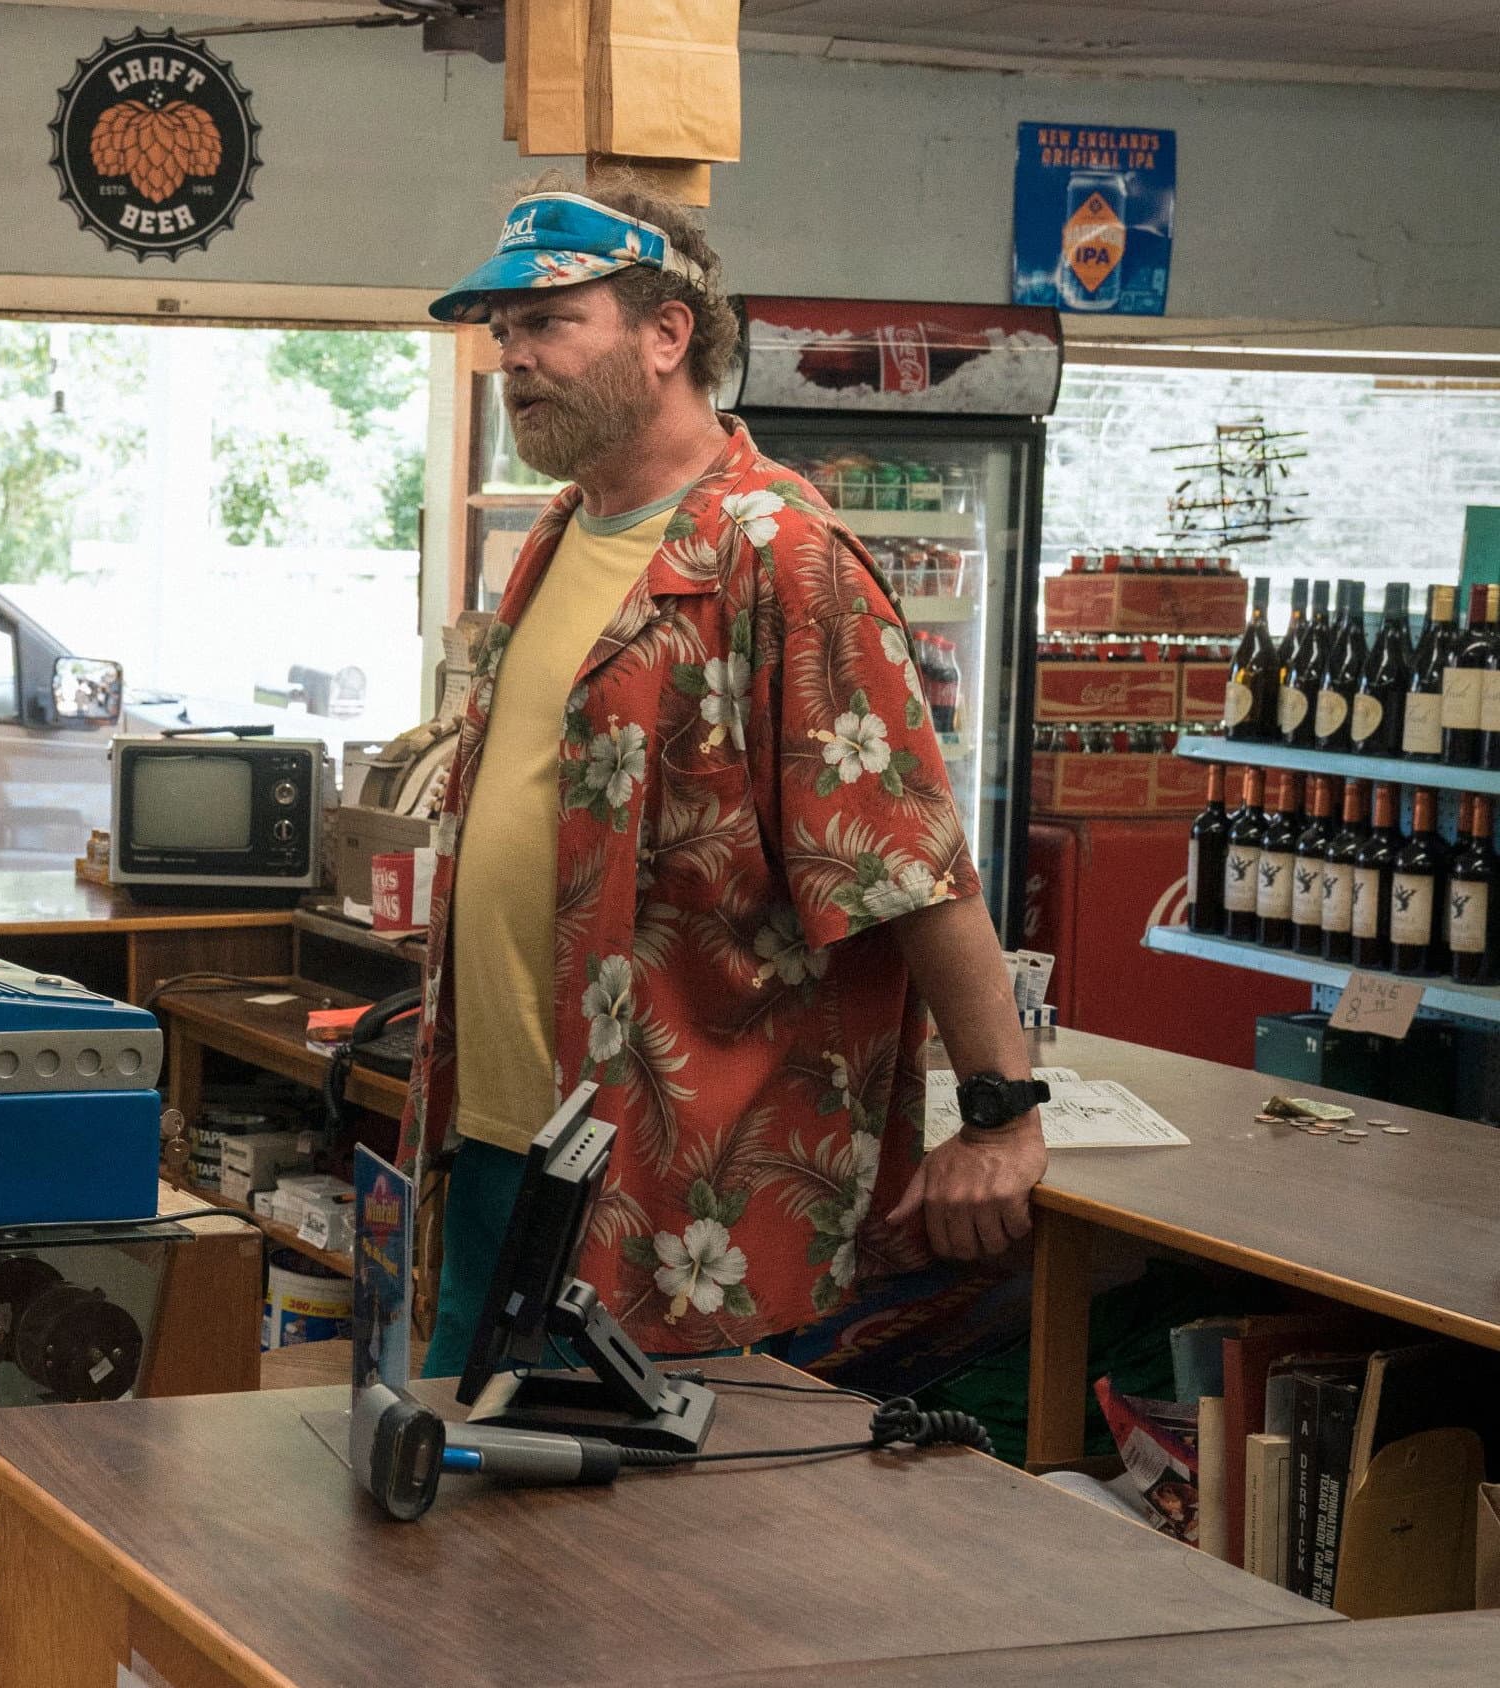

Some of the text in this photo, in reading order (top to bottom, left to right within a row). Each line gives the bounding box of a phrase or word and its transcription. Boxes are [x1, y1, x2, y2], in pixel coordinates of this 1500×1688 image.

[108, 56, 206, 93] CRAFT
[1038, 128, 1071, 146] NEW
[1041, 147, 1156, 170] ORIGINAL IPA
[119, 203, 195, 235] BEER
[1075, 247, 1111, 265] IPA
[1358, 977, 1402, 1000] WINE
[1319, 1473, 1330, 1510] TEXACO
[1297, 1453, 1309, 1572] DERRICK
[1325, 1480, 1340, 1548] INFORMATION
[1315, 1514, 1326, 1549] CREDIT
[1313, 1552, 1324, 1577] CARD
[1324, 1550, 1335, 1563] ON
[1322, 1567, 1334, 1587] THE
